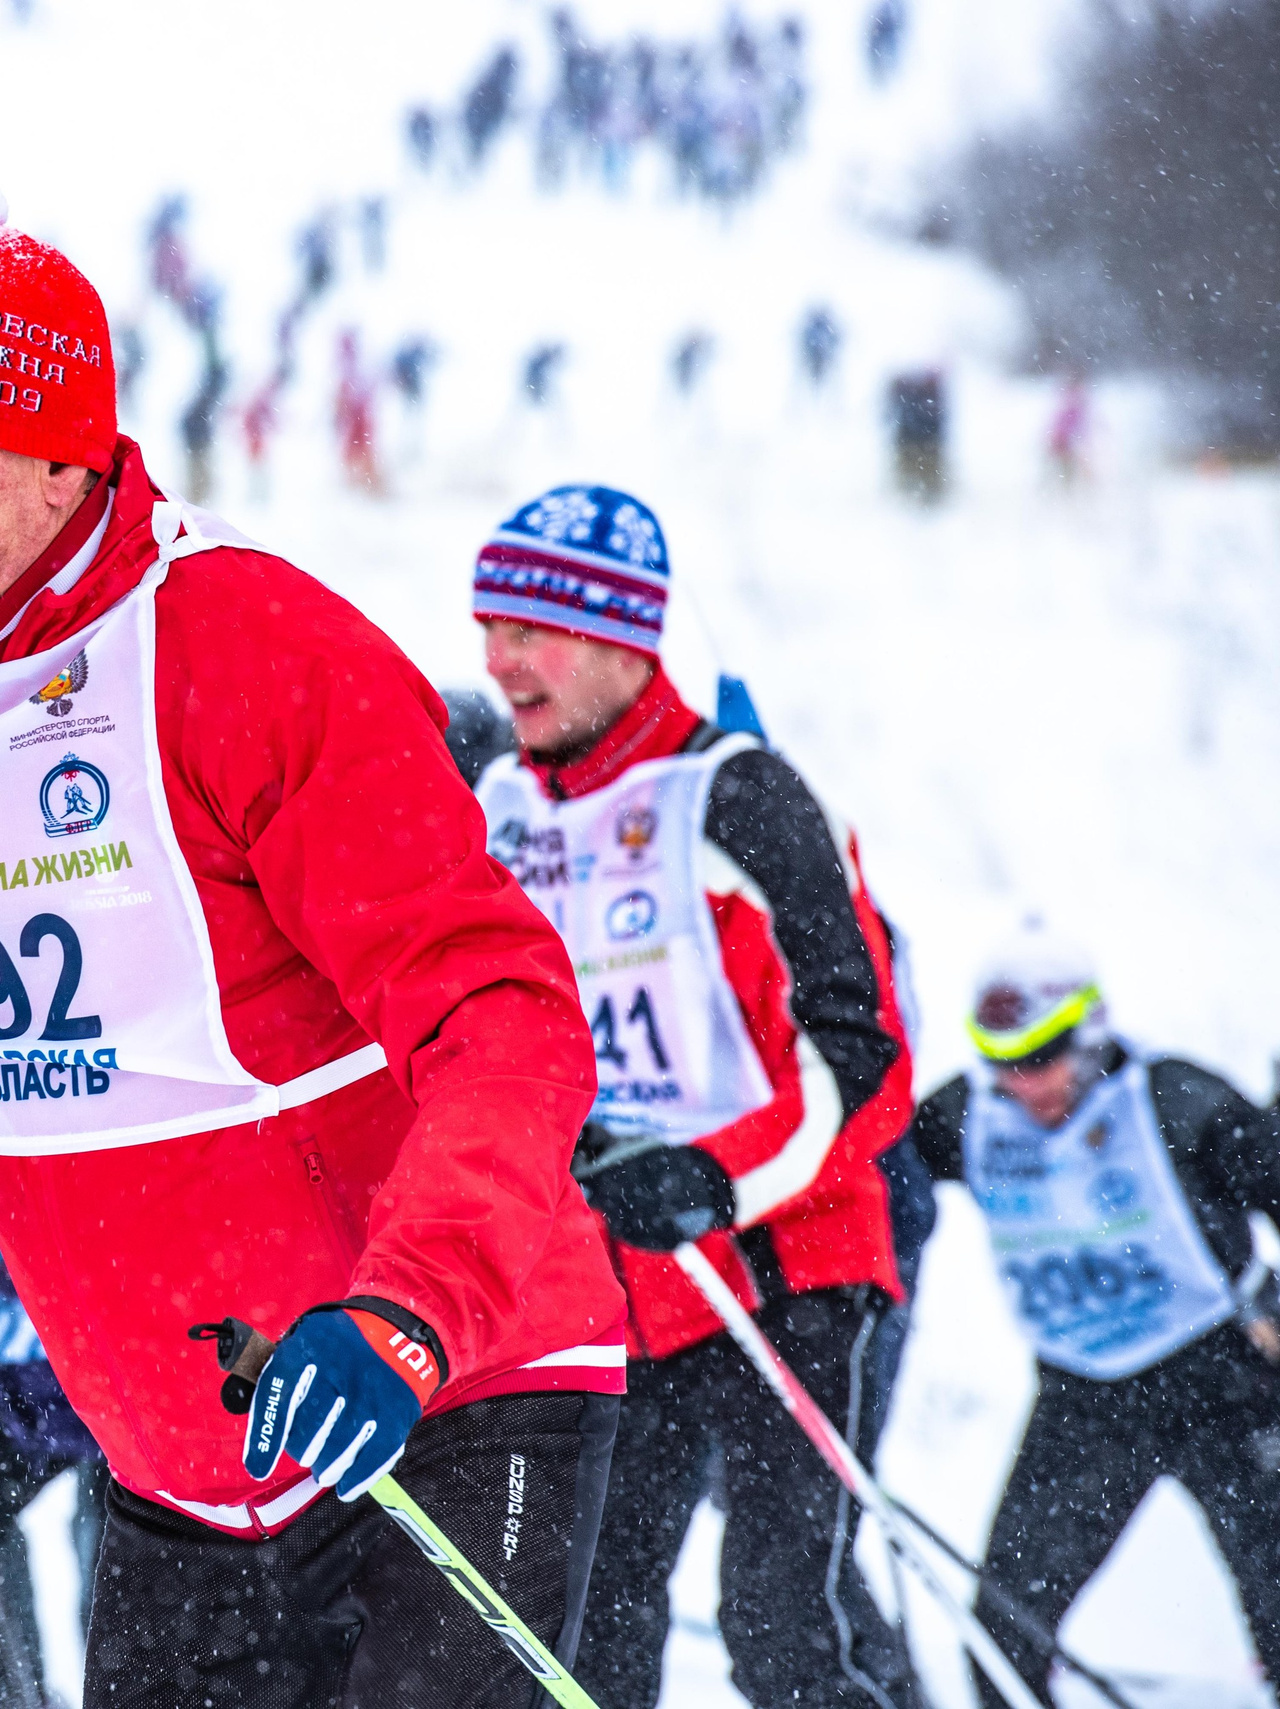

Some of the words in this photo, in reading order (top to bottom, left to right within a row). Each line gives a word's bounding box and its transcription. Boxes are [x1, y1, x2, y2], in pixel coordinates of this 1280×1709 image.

[9, 719, 76, 744] МИНИСТЕРСТВО
[77, 714, 111, 727] СПОРТА
[9, 729, 68, 752] РОССИЙСКОЙ
[68, 723, 117, 739] ФЕДЕРАЦИИ
[31, 840, 134, 887] ЖИЗНИ
